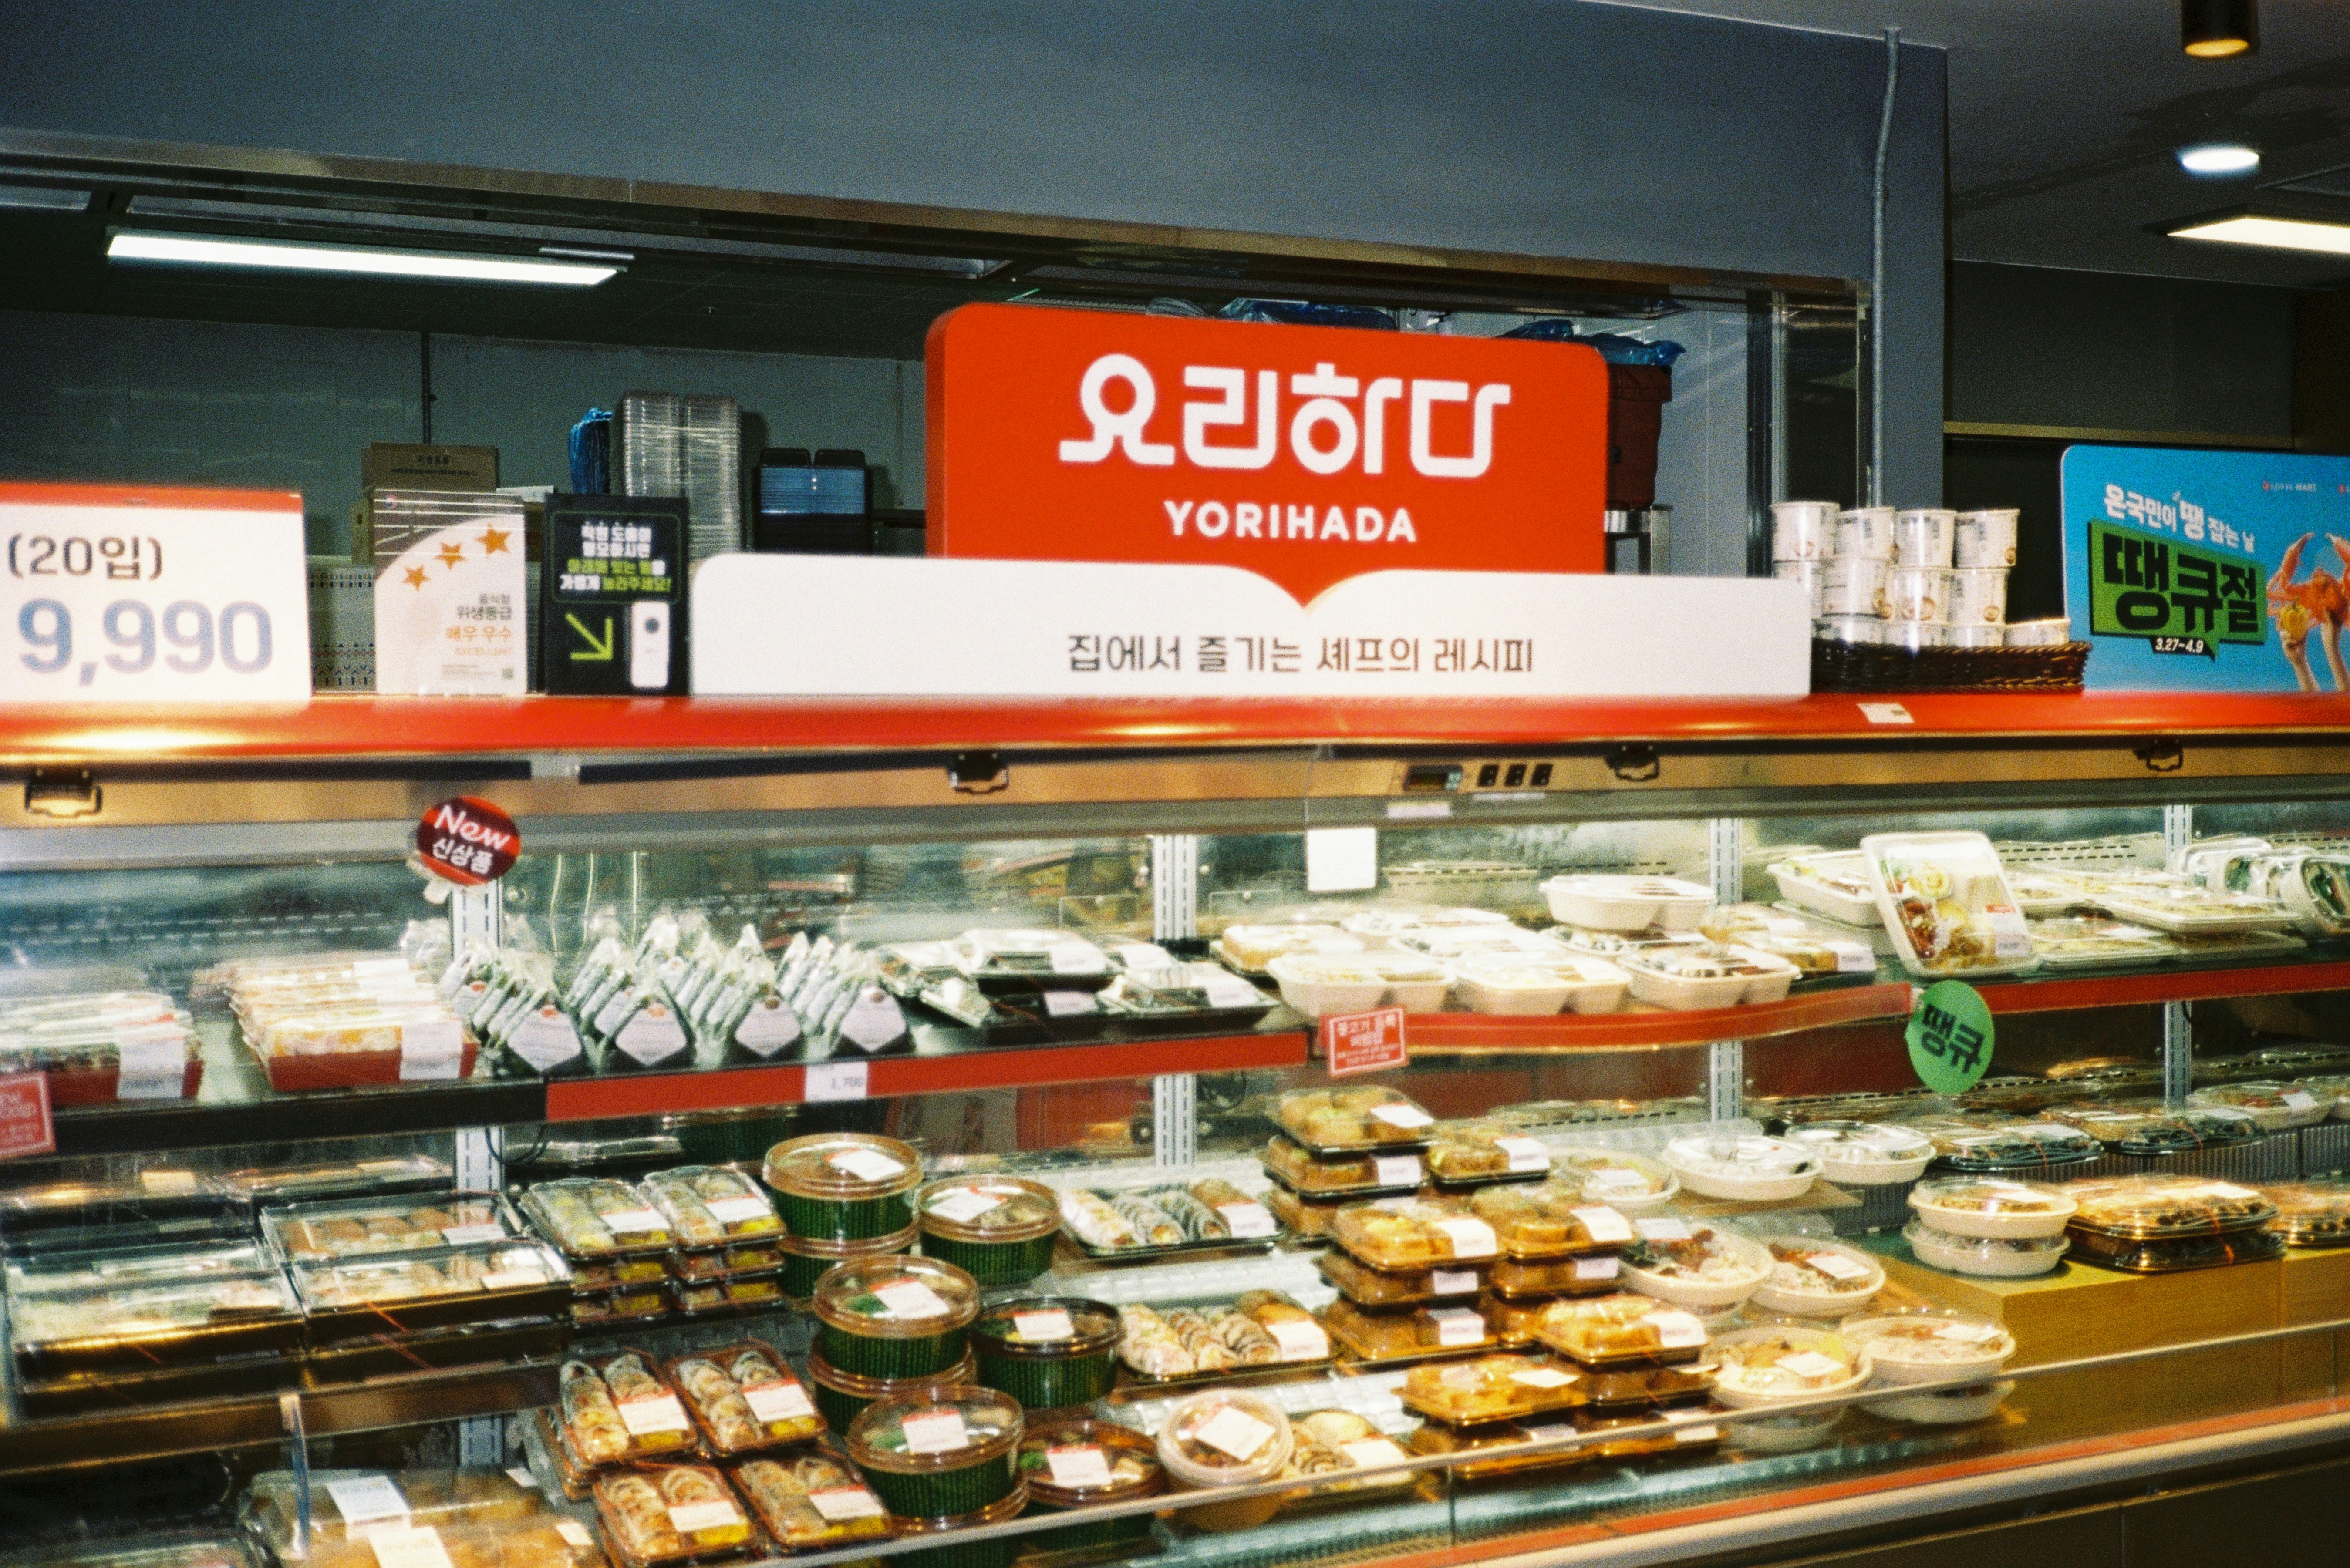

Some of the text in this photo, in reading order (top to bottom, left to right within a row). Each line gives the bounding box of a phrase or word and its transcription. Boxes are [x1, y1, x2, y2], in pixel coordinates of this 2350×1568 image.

[1058, 353, 1511, 478] 요리하다
[1163, 501, 1416, 542] YORIHADA
[2104, 483, 2176, 533] 온국민이
[2208, 517, 2239, 548] 잡는
[2242, 531, 2255, 554] 날
[7, 533, 162, 581] (20입)
[2103, 532, 2259, 633] 땡큐절
[445, 625, 512, 642] 매우 우수
[457, 605, 512, 621] 위생등급
[18, 597, 273, 687] 9,990
[1068, 635, 1533, 673] 집에서 즐기는 셰프의 레시피
[434, 805, 511, 850] New
[432, 838, 494, 874] 신상품
[1921, 1003, 1984, 1074] 땡큐
